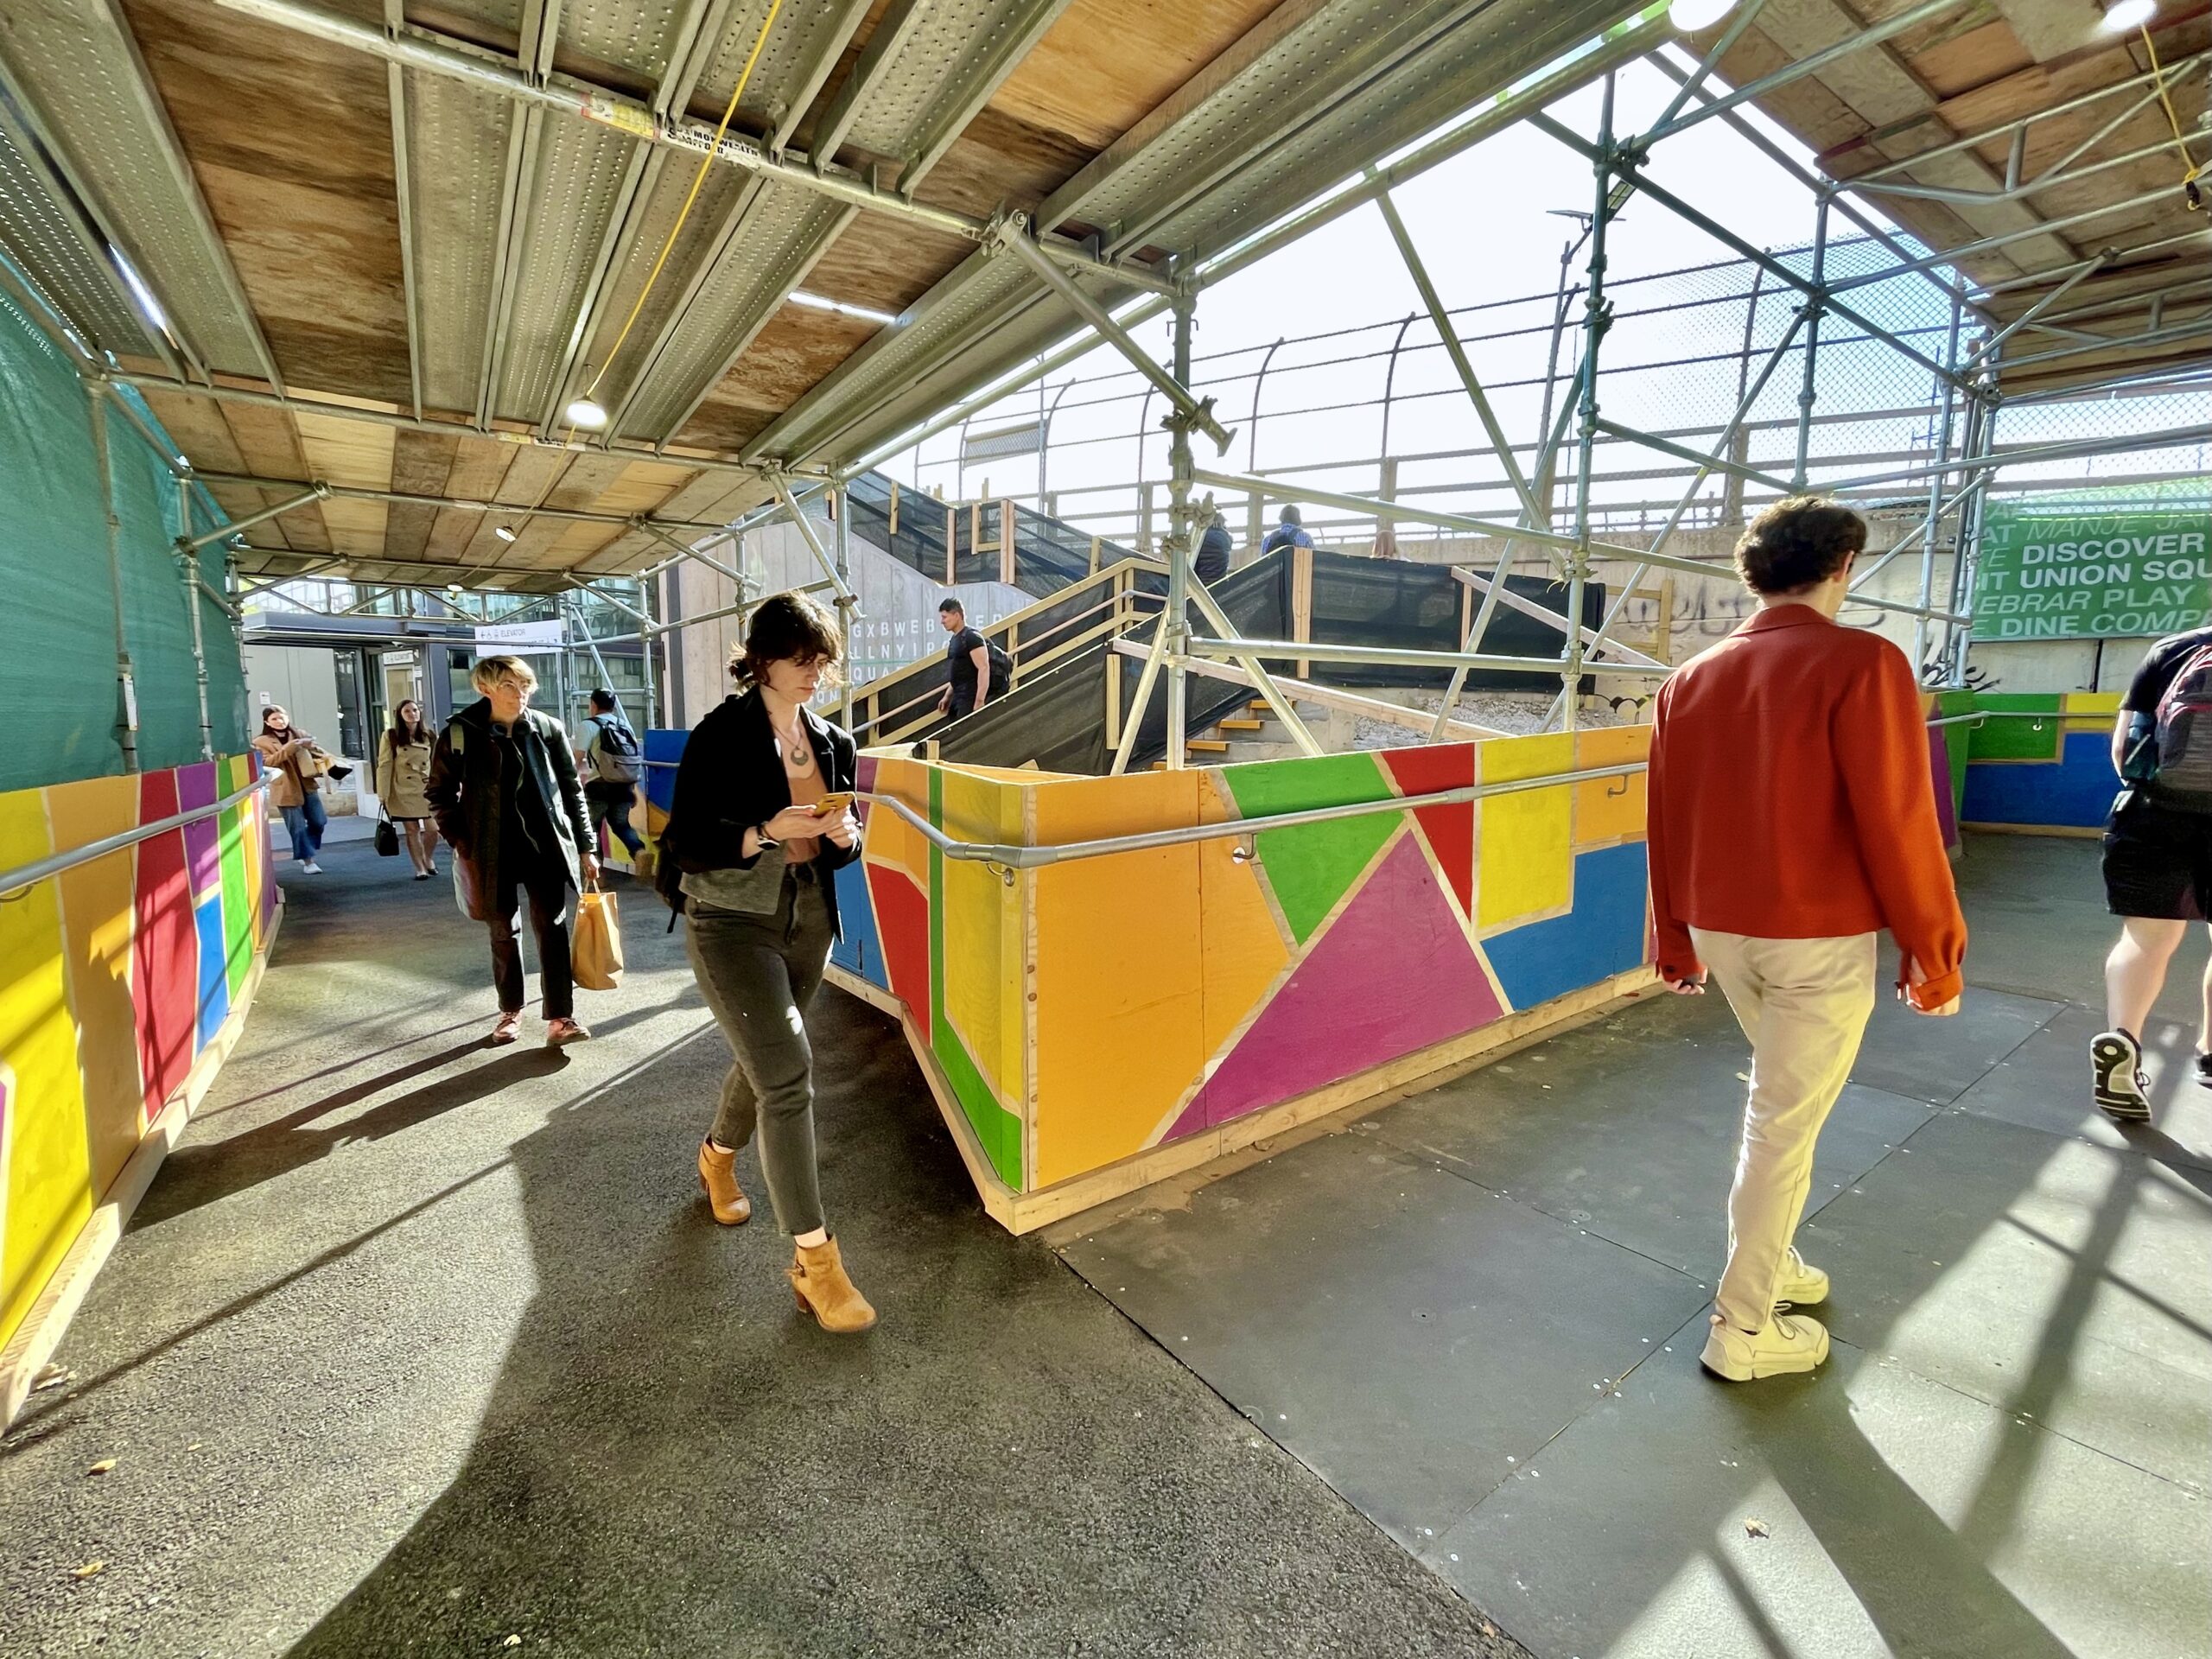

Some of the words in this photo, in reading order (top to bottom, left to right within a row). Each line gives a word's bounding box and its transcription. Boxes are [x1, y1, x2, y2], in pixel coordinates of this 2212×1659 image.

[2022, 532, 2206, 565] DISCOVER
[2020, 563, 2132, 588] UNION
[1978, 590, 2092, 615] EBRAR
[2102, 584, 2196, 609] PLAY
[500, 628, 526, 638] ELEVATOR
[2000, 615, 2080, 637] DINE
